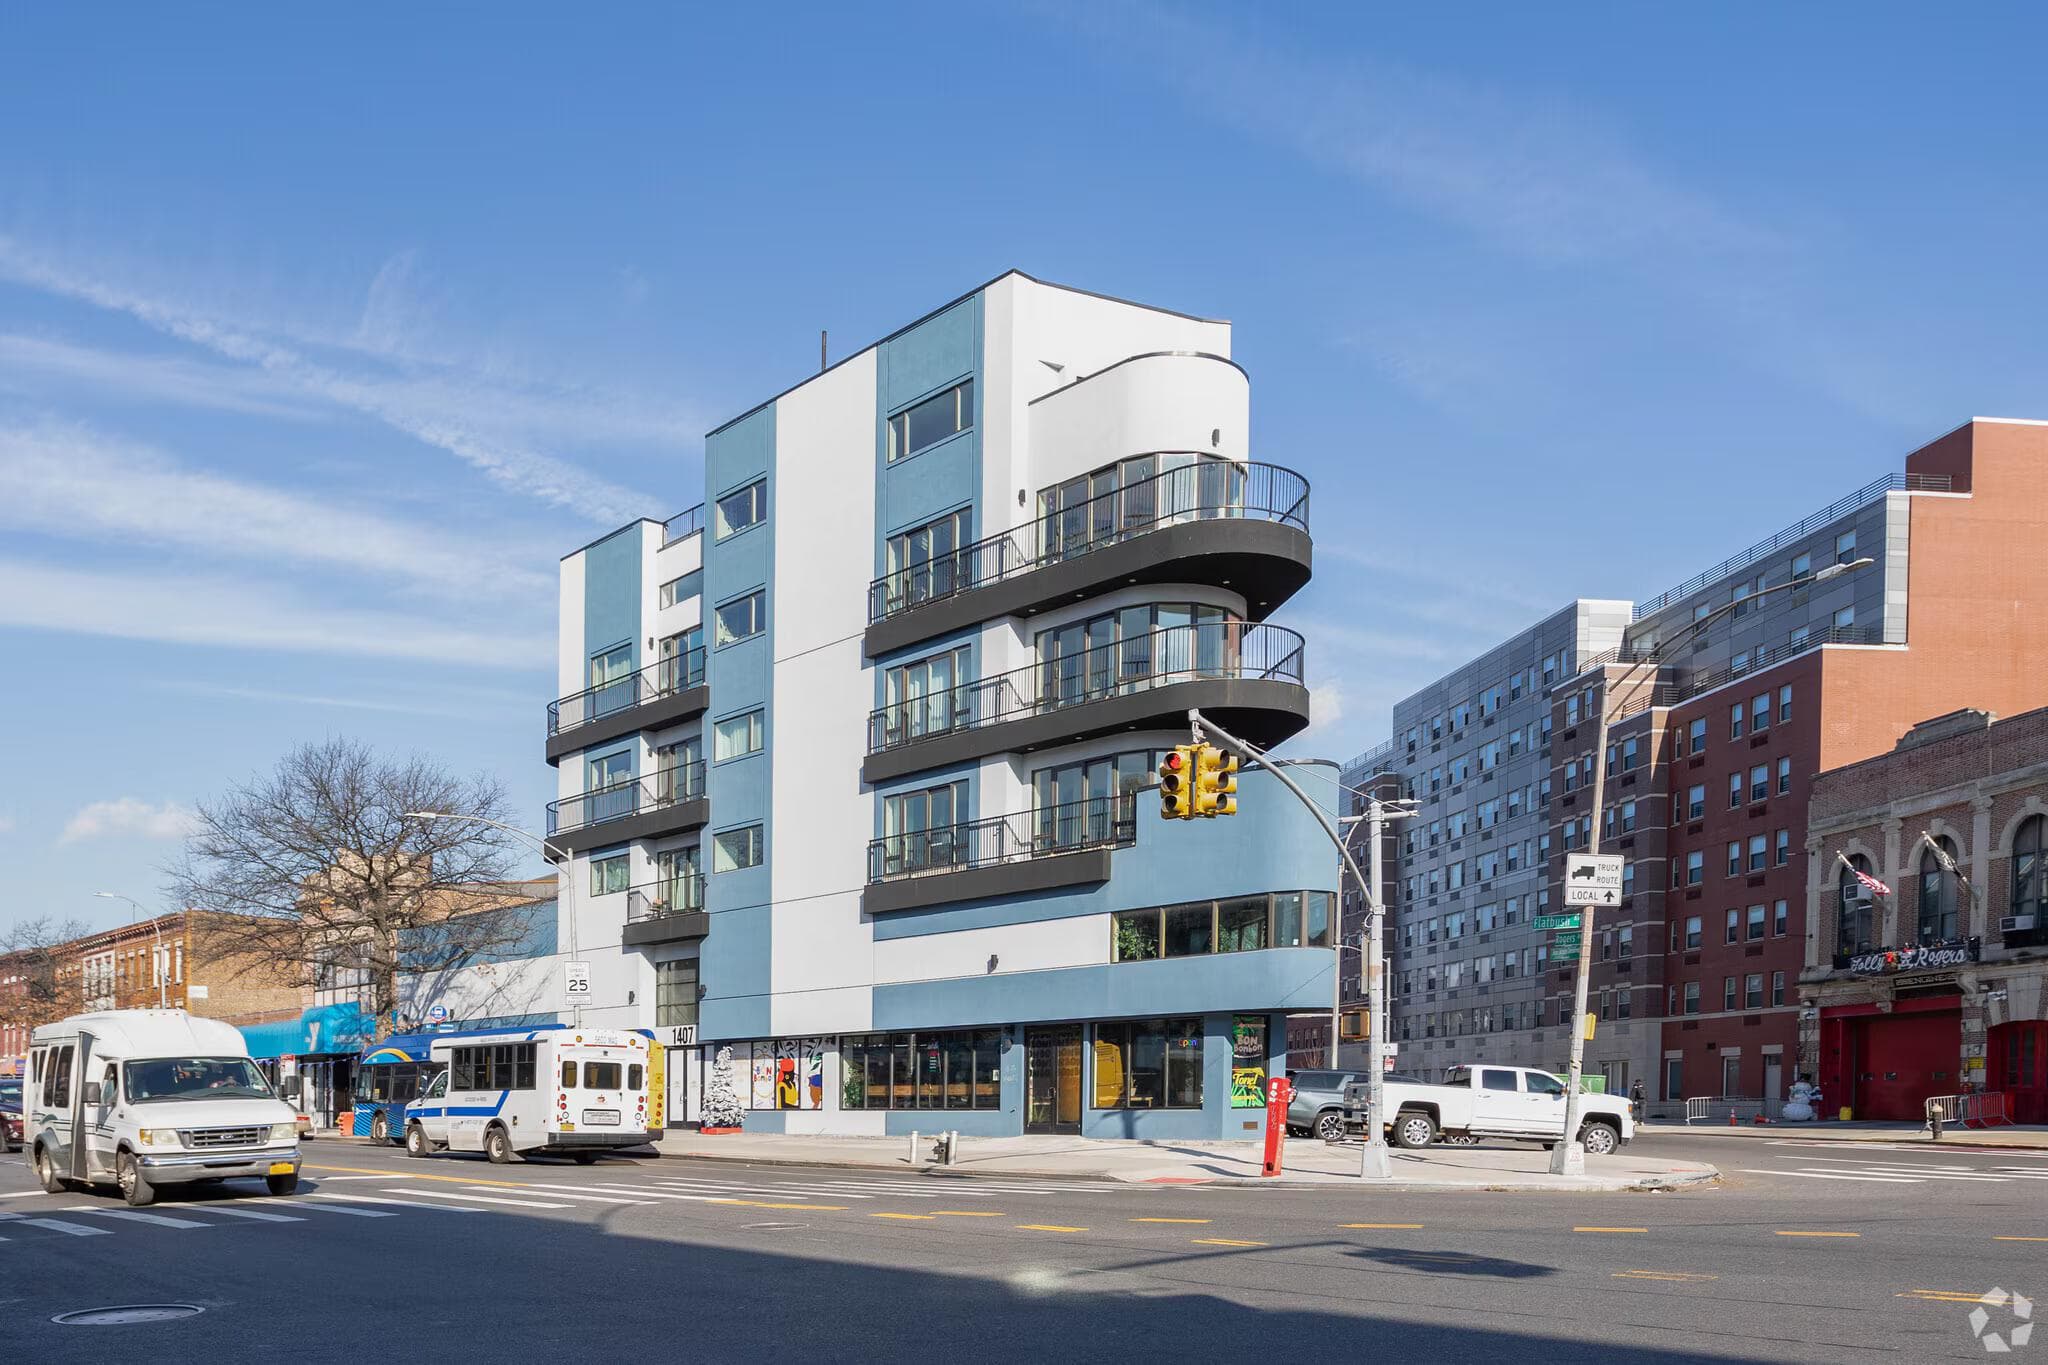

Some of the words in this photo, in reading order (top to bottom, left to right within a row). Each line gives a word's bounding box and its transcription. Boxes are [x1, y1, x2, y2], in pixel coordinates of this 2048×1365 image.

[1598, 863, 1619, 871] TRUCK
[1597, 876, 1619, 884] ROUTE
[1572, 890, 1598, 901] LOCAL
[1533, 915, 1570, 929] Flatbush
[1914, 947, 1967, 967] Rogers
[568, 979, 588, 991] 25
[672, 1026, 694, 1045] 1407
[1237, 1034, 1258, 1046] BON
